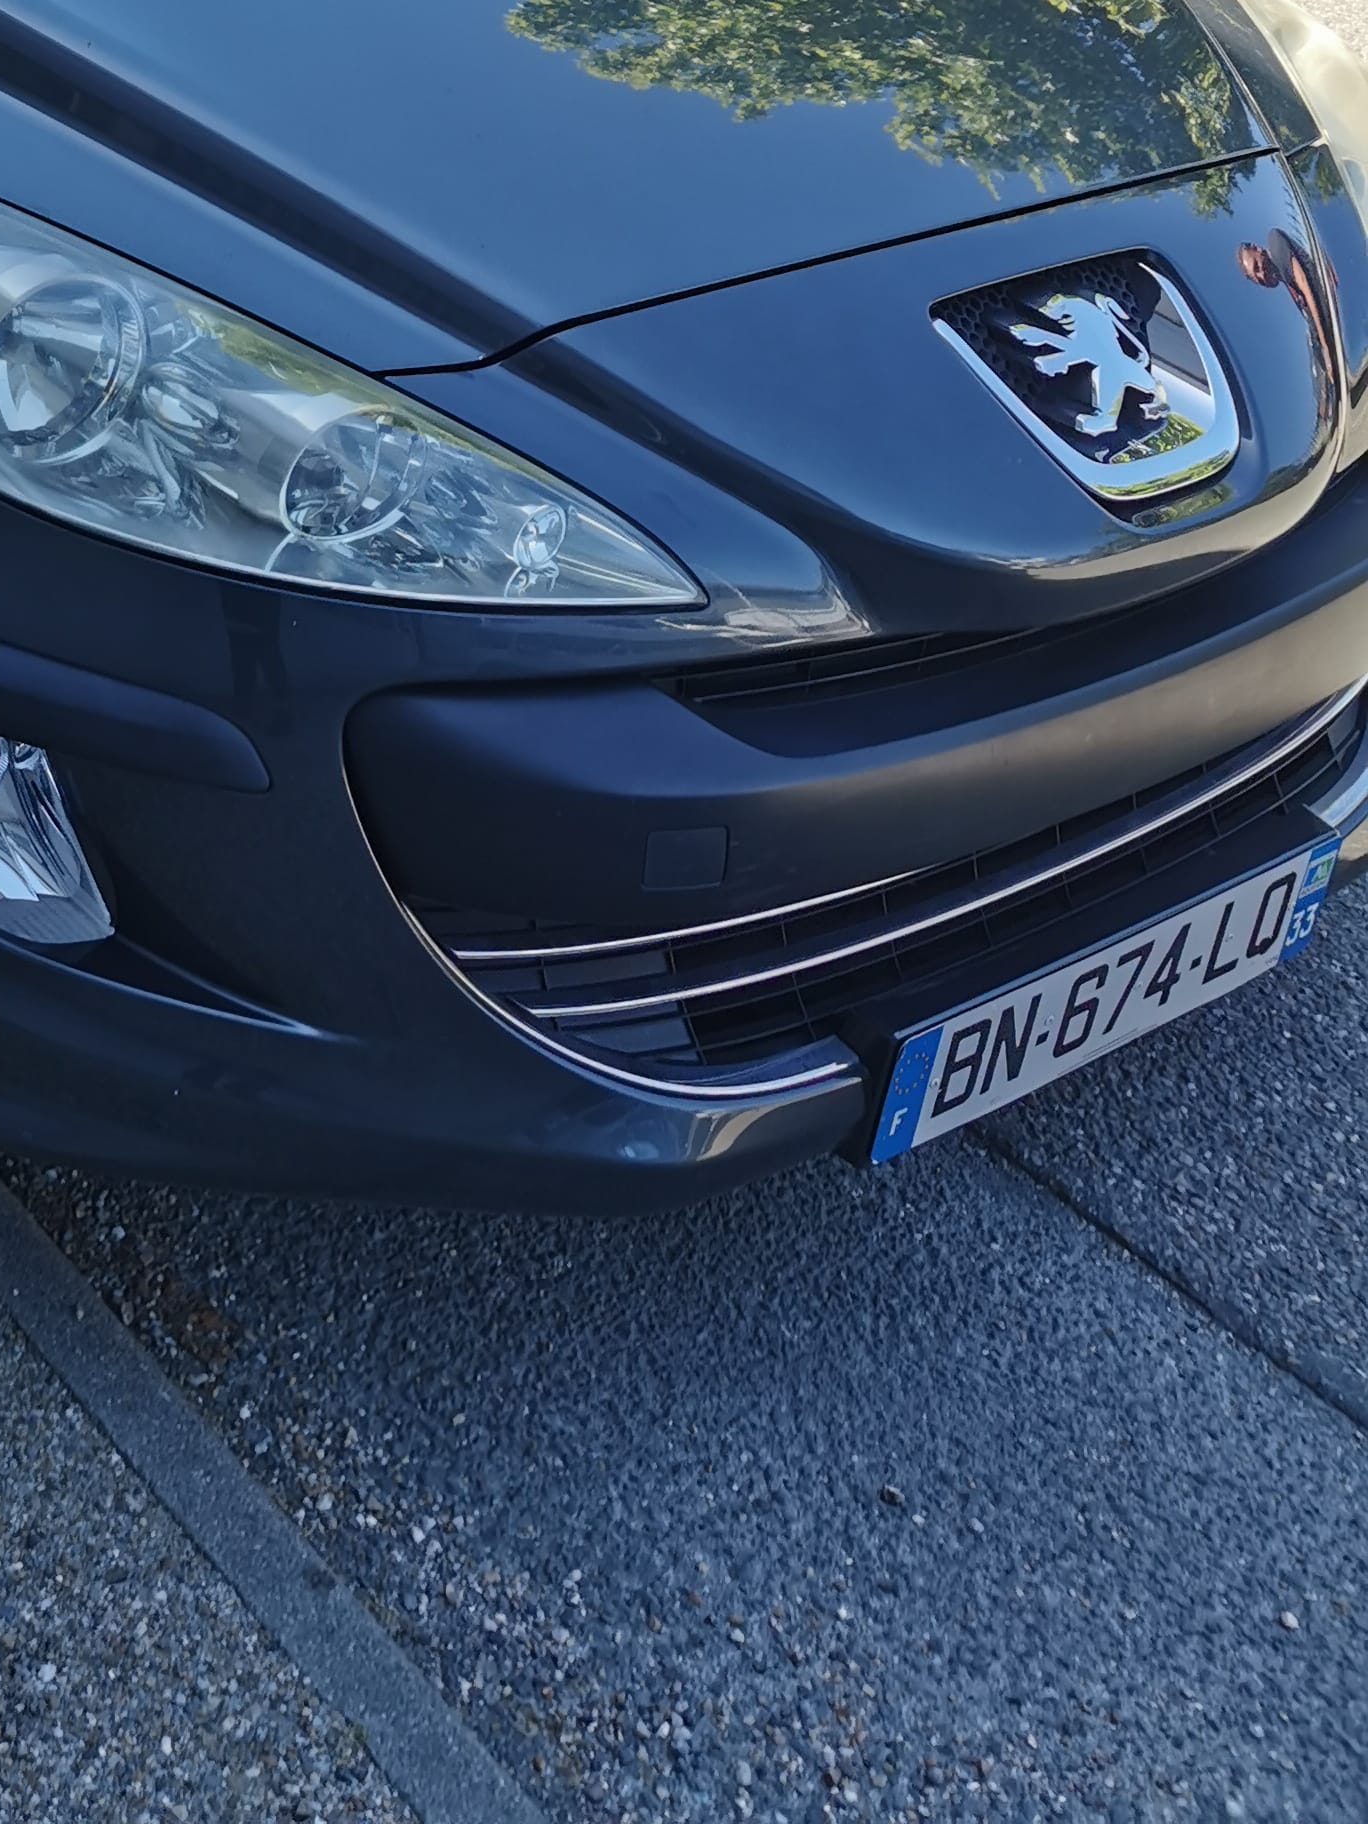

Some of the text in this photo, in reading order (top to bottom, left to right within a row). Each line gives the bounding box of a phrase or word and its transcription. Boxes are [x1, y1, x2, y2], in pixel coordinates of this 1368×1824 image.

[889, 1107, 908, 1136] F
[930, 871, 1297, 1119] BN-674-LQ
[1285, 902, 1319, 947] 33
